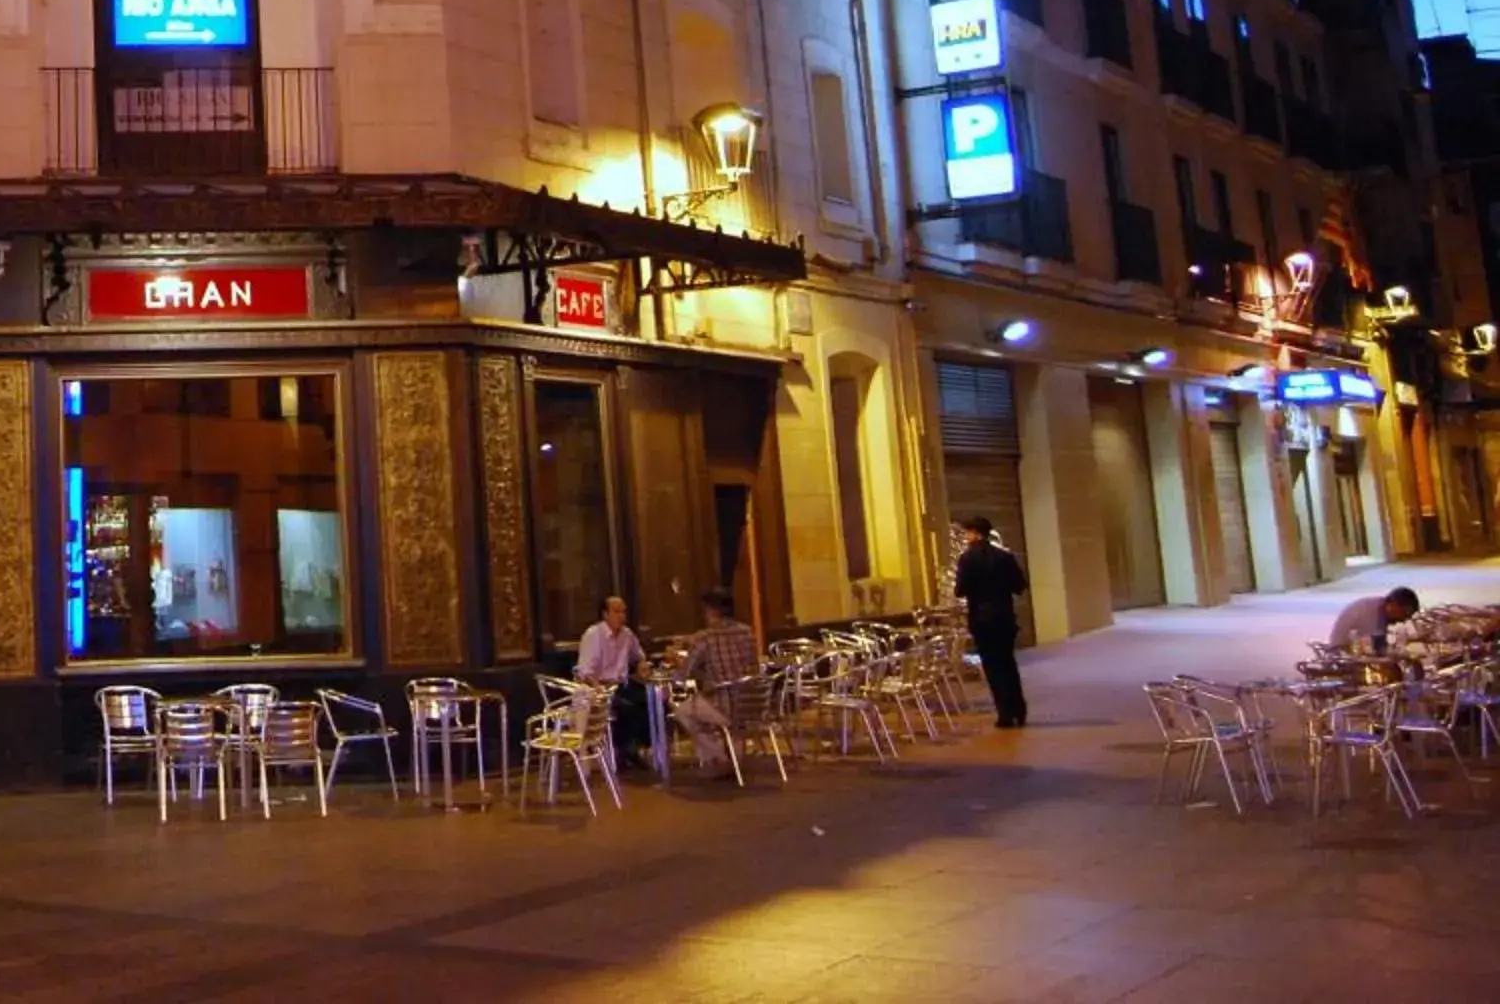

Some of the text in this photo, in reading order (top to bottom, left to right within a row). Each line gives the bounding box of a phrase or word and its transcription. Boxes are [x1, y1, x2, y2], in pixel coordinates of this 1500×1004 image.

[951, 104, 998, 154] P
[144, 279, 252, 309] GRAN
[556, 288, 603, 319] CAFE
